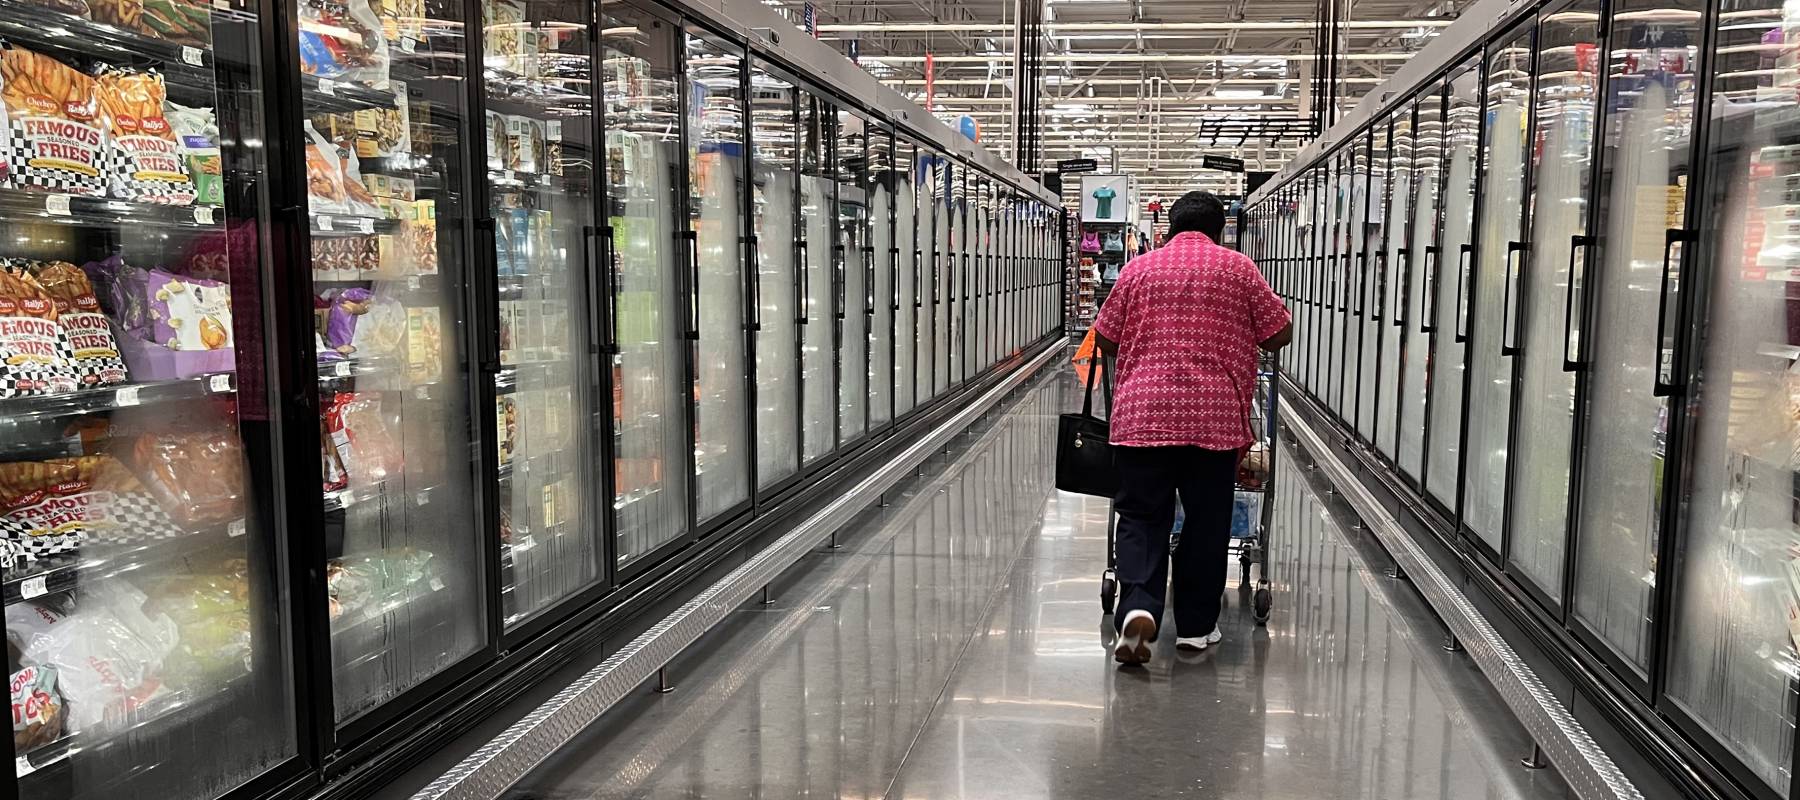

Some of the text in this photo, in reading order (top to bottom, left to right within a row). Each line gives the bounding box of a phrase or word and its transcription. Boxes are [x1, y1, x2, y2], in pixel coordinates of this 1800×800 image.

[142, 120, 164, 130] Rally's
[25, 120, 100, 146] FAMOUS
[47, 136, 80, 147] SEASONED
[37, 142, 90, 164] FRIES
[137, 157, 177, 173] RIES
[24, 300, 44, 309] Rally's
[77, 296, 97, 305] Rally's
[67, 329, 97, 337] SEASONED
[71, 334, 109, 349] RIES
[9, 494, 109, 521] FAMOUS
